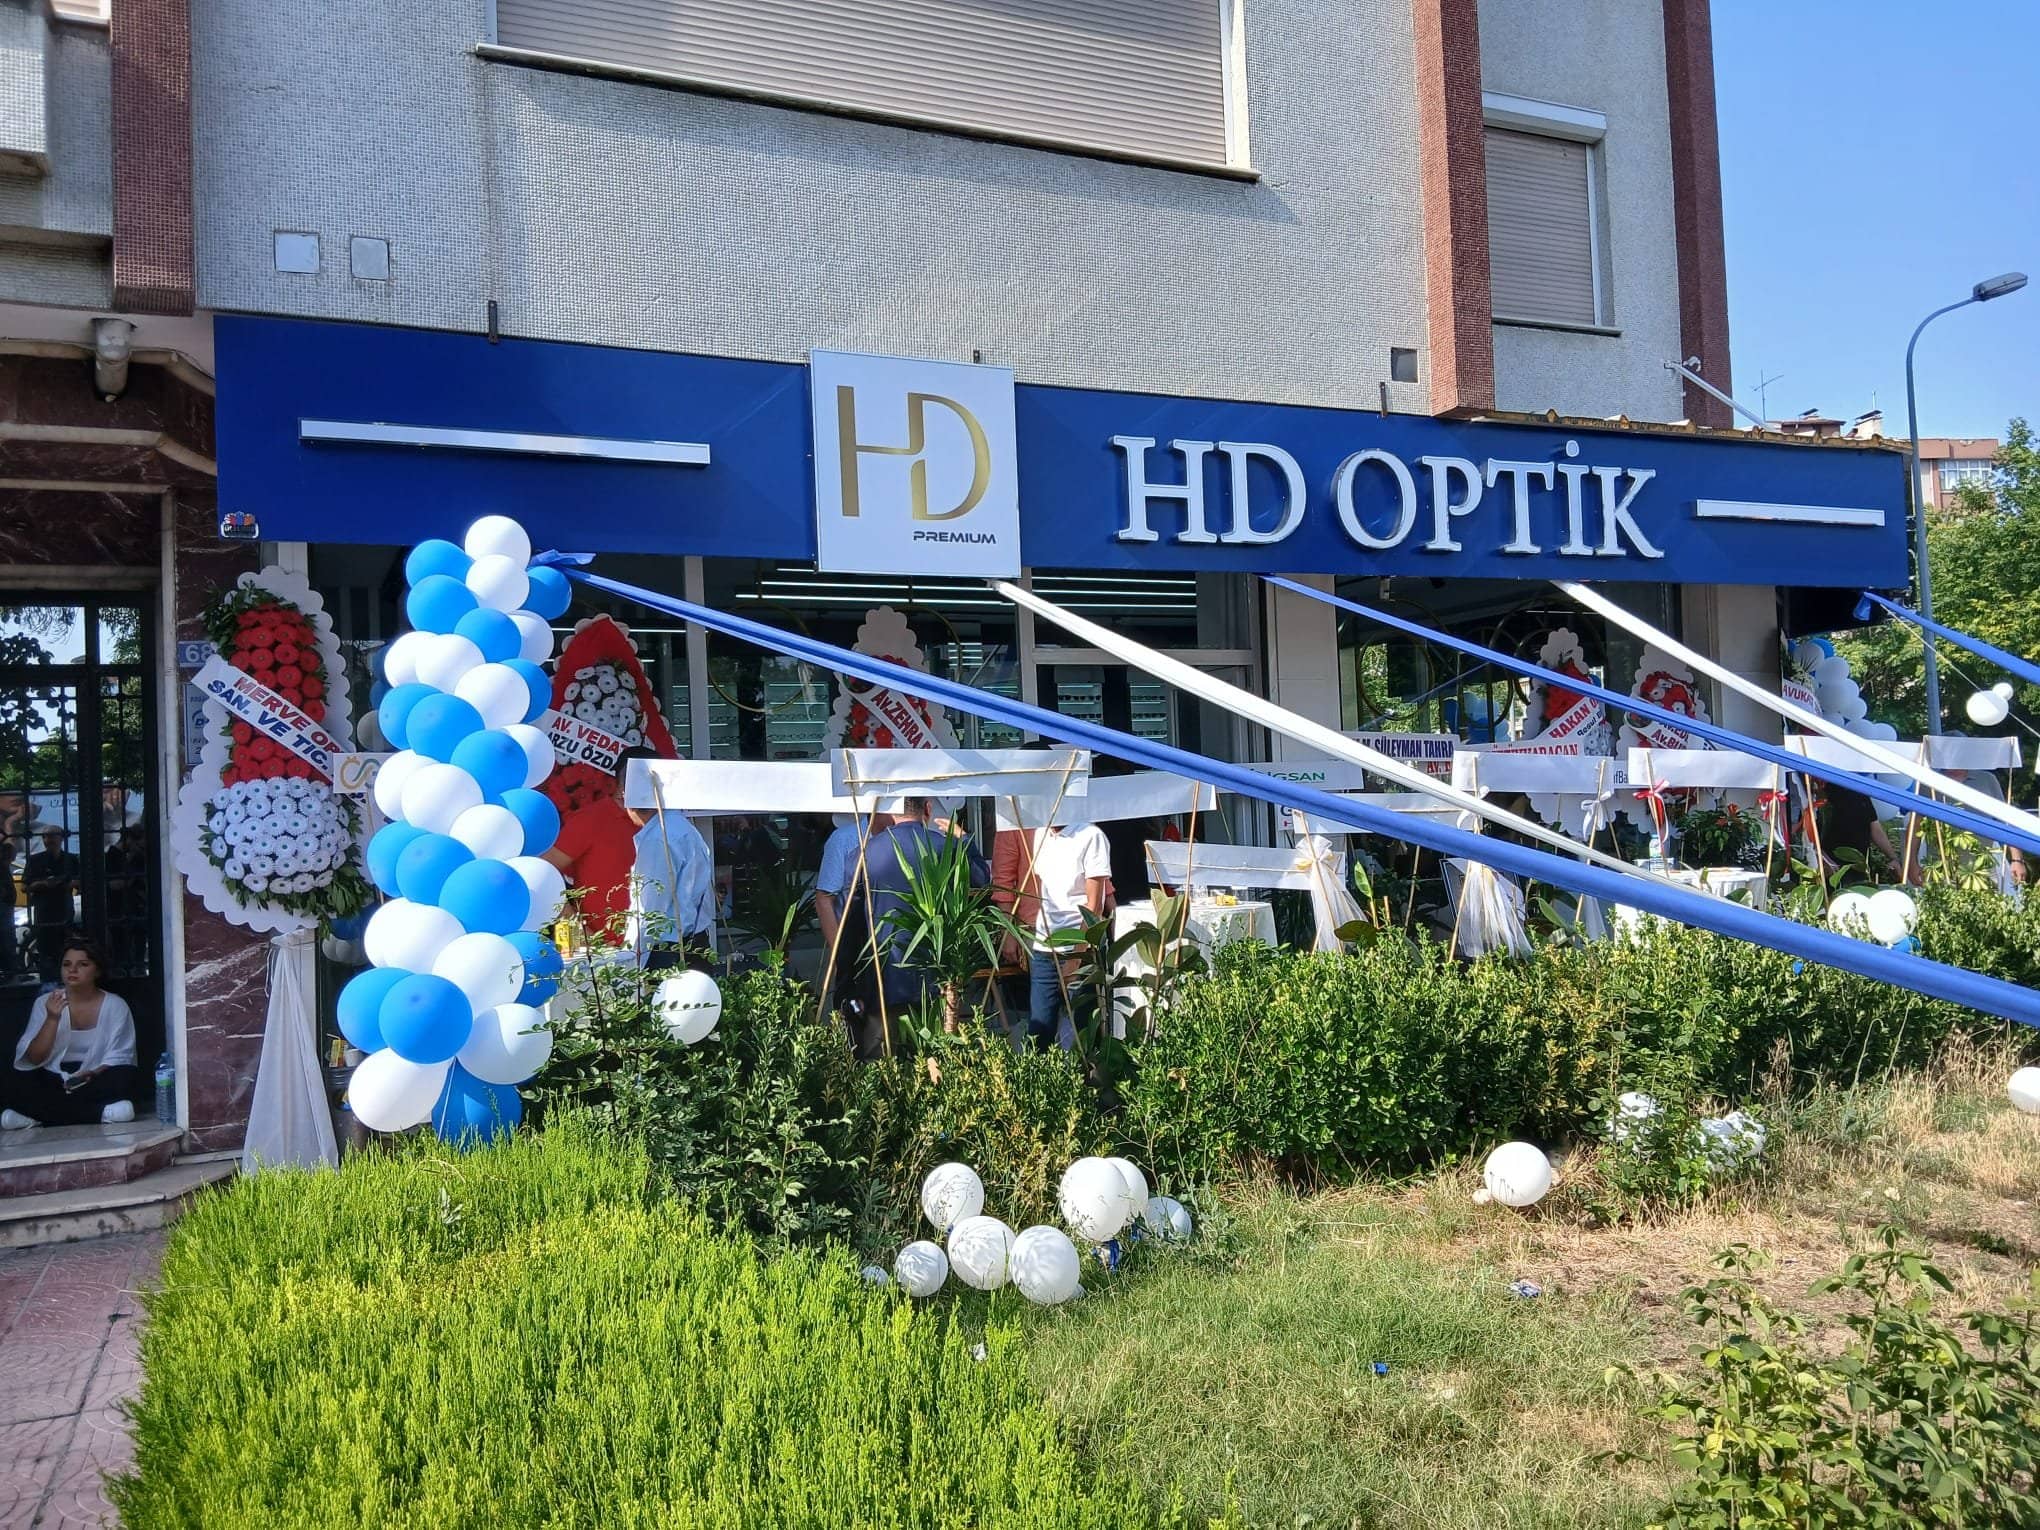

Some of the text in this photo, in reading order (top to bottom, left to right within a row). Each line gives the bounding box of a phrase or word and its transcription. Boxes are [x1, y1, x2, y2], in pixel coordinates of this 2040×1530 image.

[836, 384, 992, 521] HD
[1112, 433, 1666, 560] HD OPTİK
[912, 530, 997, 545] PREMIUM
[207, 679, 251, 715] SAN.
[257, 710, 292, 738] VE
[233, 676, 345, 754] MERVE OP
[551, 716, 573, 734] AV.
[1548, 703, 1591, 738] HAKAN
[581, 744, 616, 771] ÖZD
[1374, 735, 1422, 758] SÜLEYMAN
